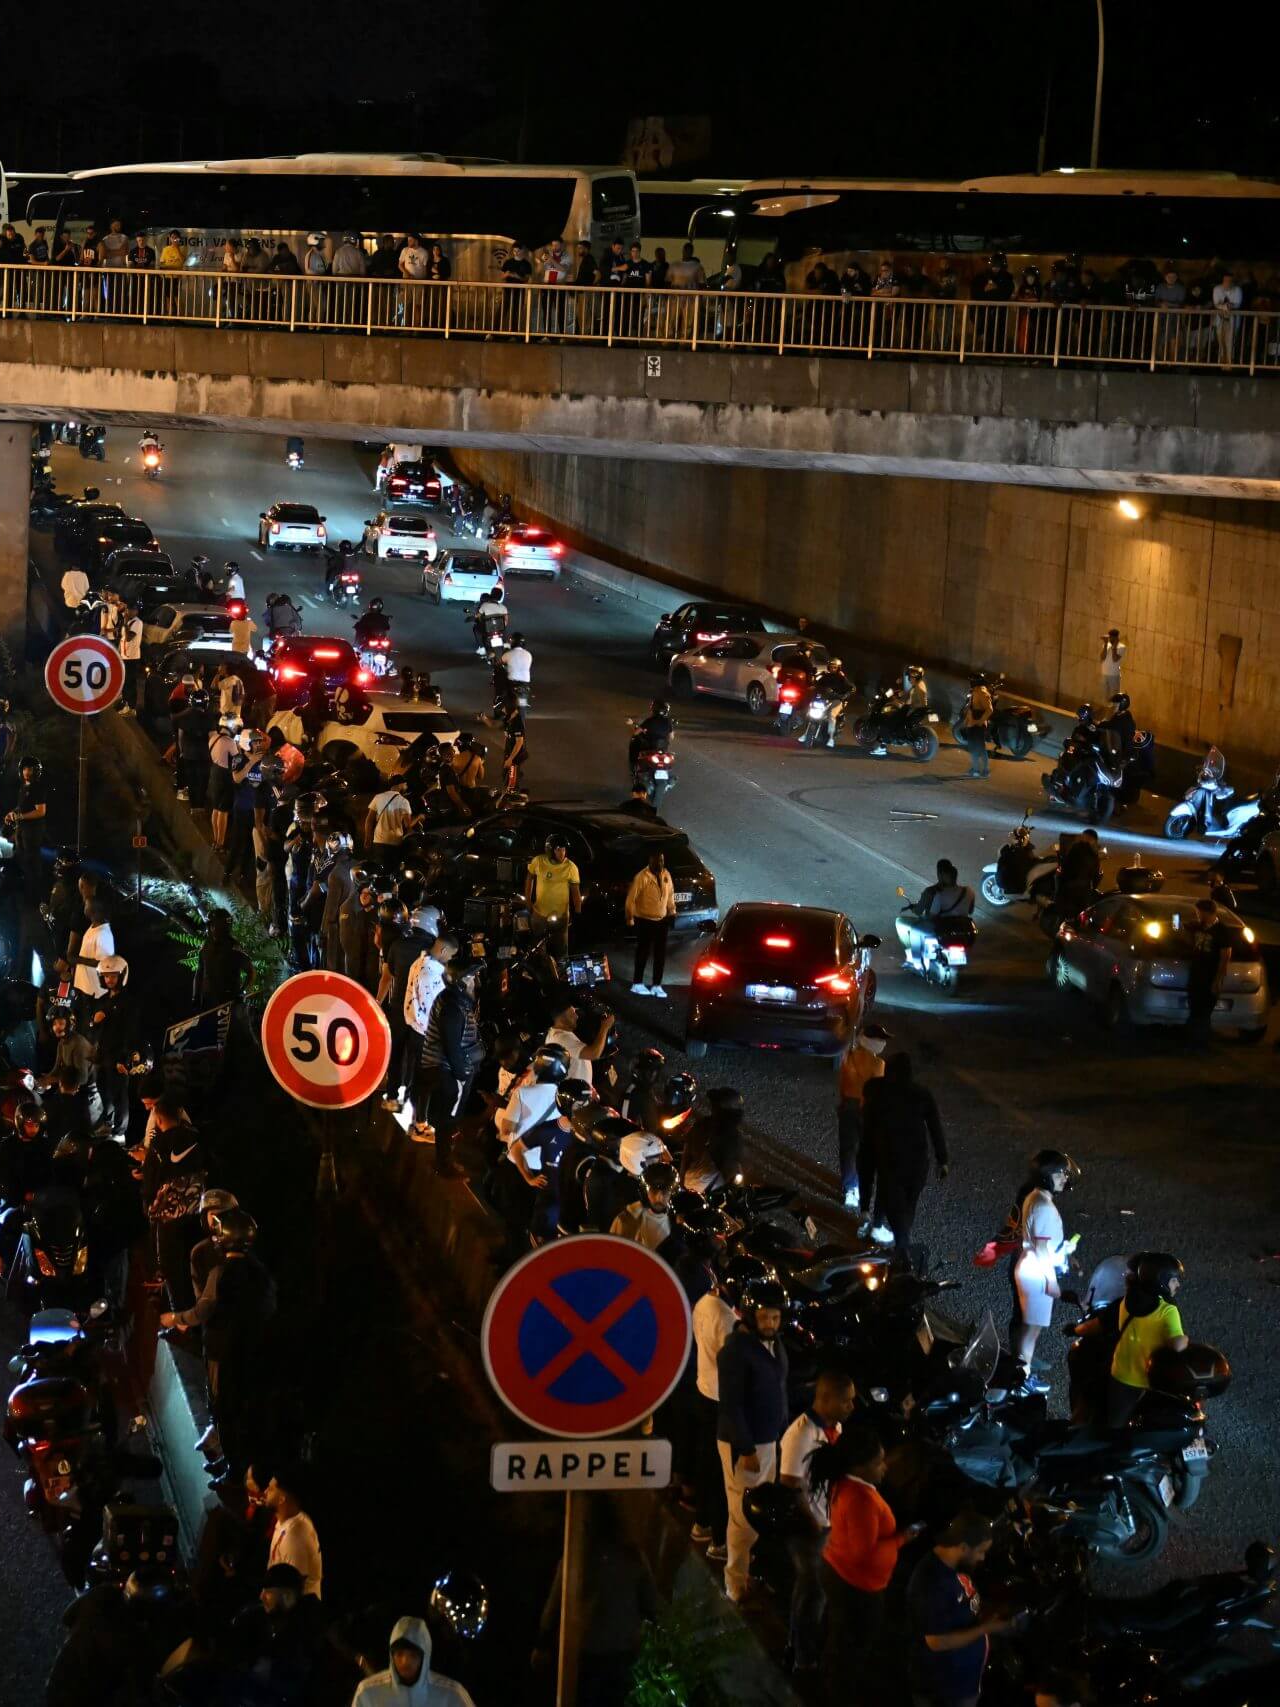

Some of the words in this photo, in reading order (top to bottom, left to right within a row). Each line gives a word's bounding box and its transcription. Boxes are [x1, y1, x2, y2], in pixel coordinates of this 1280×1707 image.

[166, 236, 208, 247] ISIGHT
[64, 660, 107, 690] 50
[290, 1013, 360, 1066] 50
[507, 1452, 656, 1480] RAPPEL
